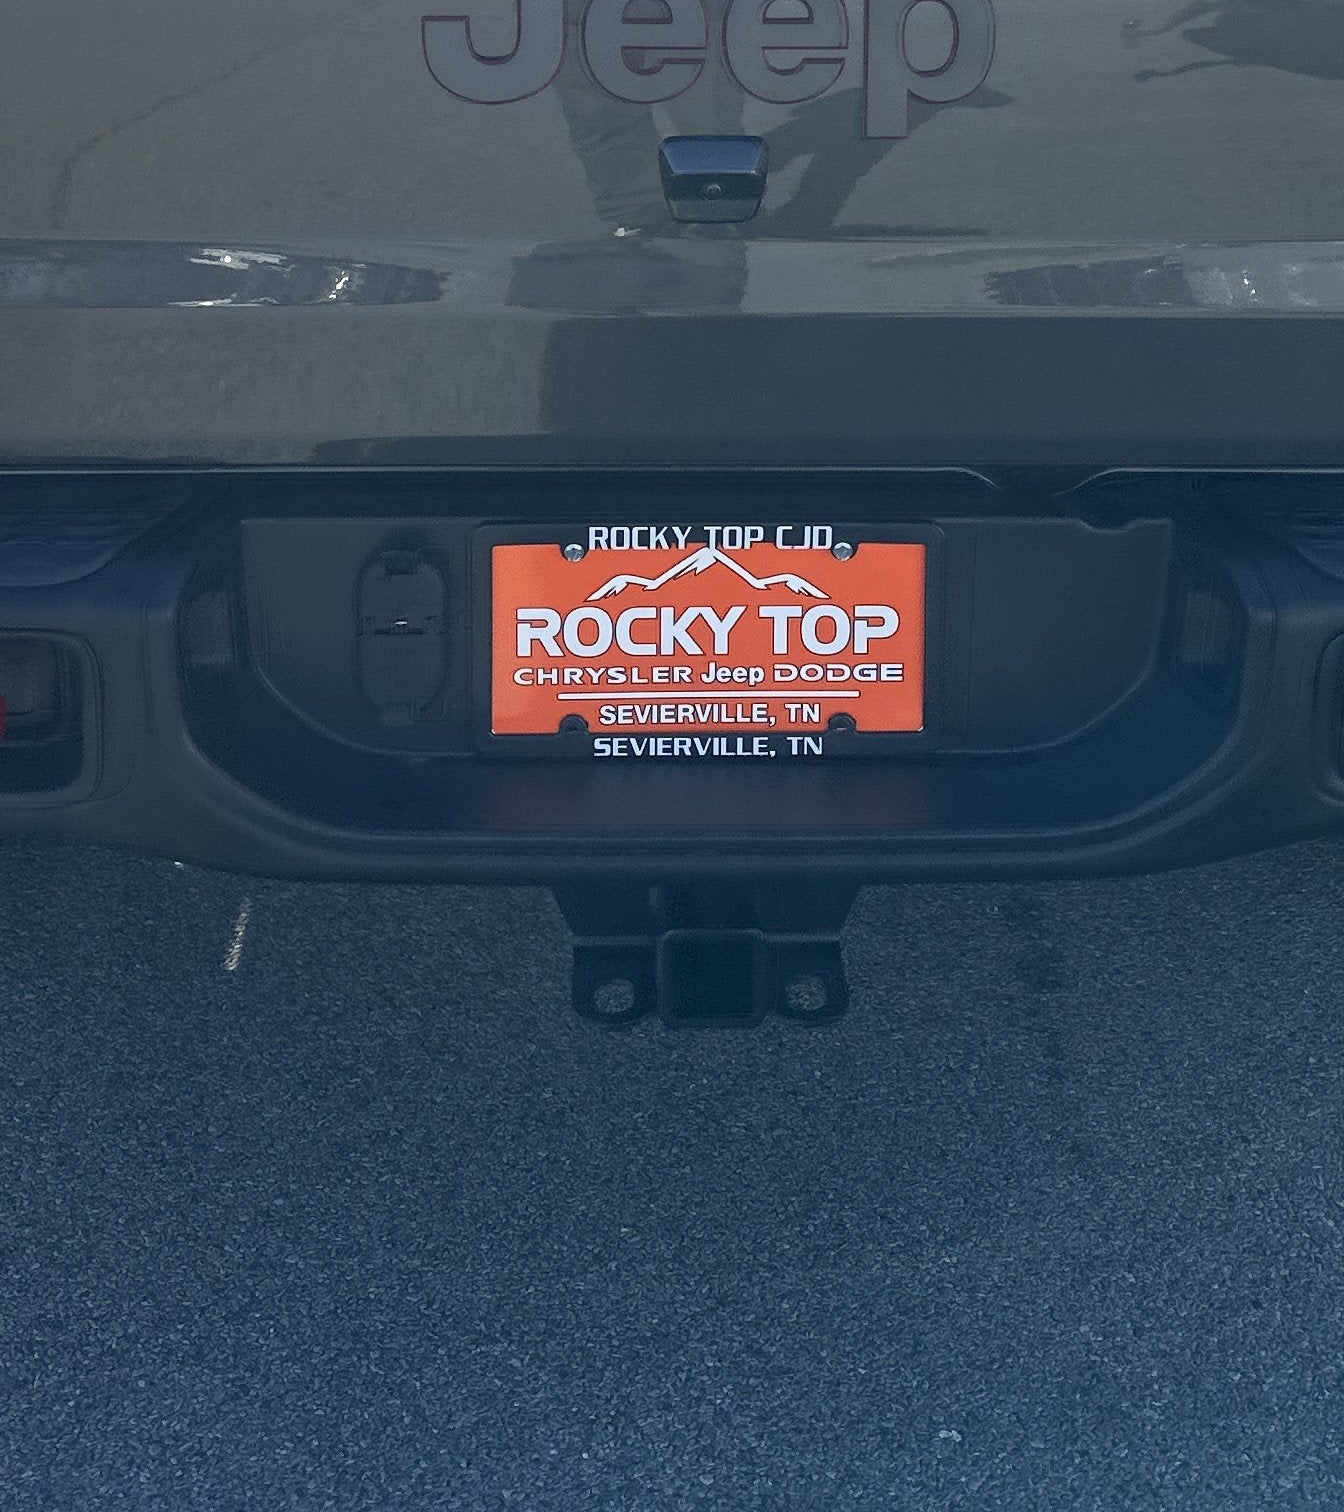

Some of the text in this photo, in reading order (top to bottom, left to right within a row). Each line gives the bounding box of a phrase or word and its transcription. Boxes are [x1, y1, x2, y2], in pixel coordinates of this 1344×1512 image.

[588, 525, 833, 550] ROCKY TOP CJD
[516, 604, 901, 657] ROCKY TOP
[513, 662, 904, 685] CHRYSLER Jeep DODGE
[599, 703, 820, 727] SEVIERVILLE, TN
[593, 736, 823, 758] SEVIERVILLE, TN
